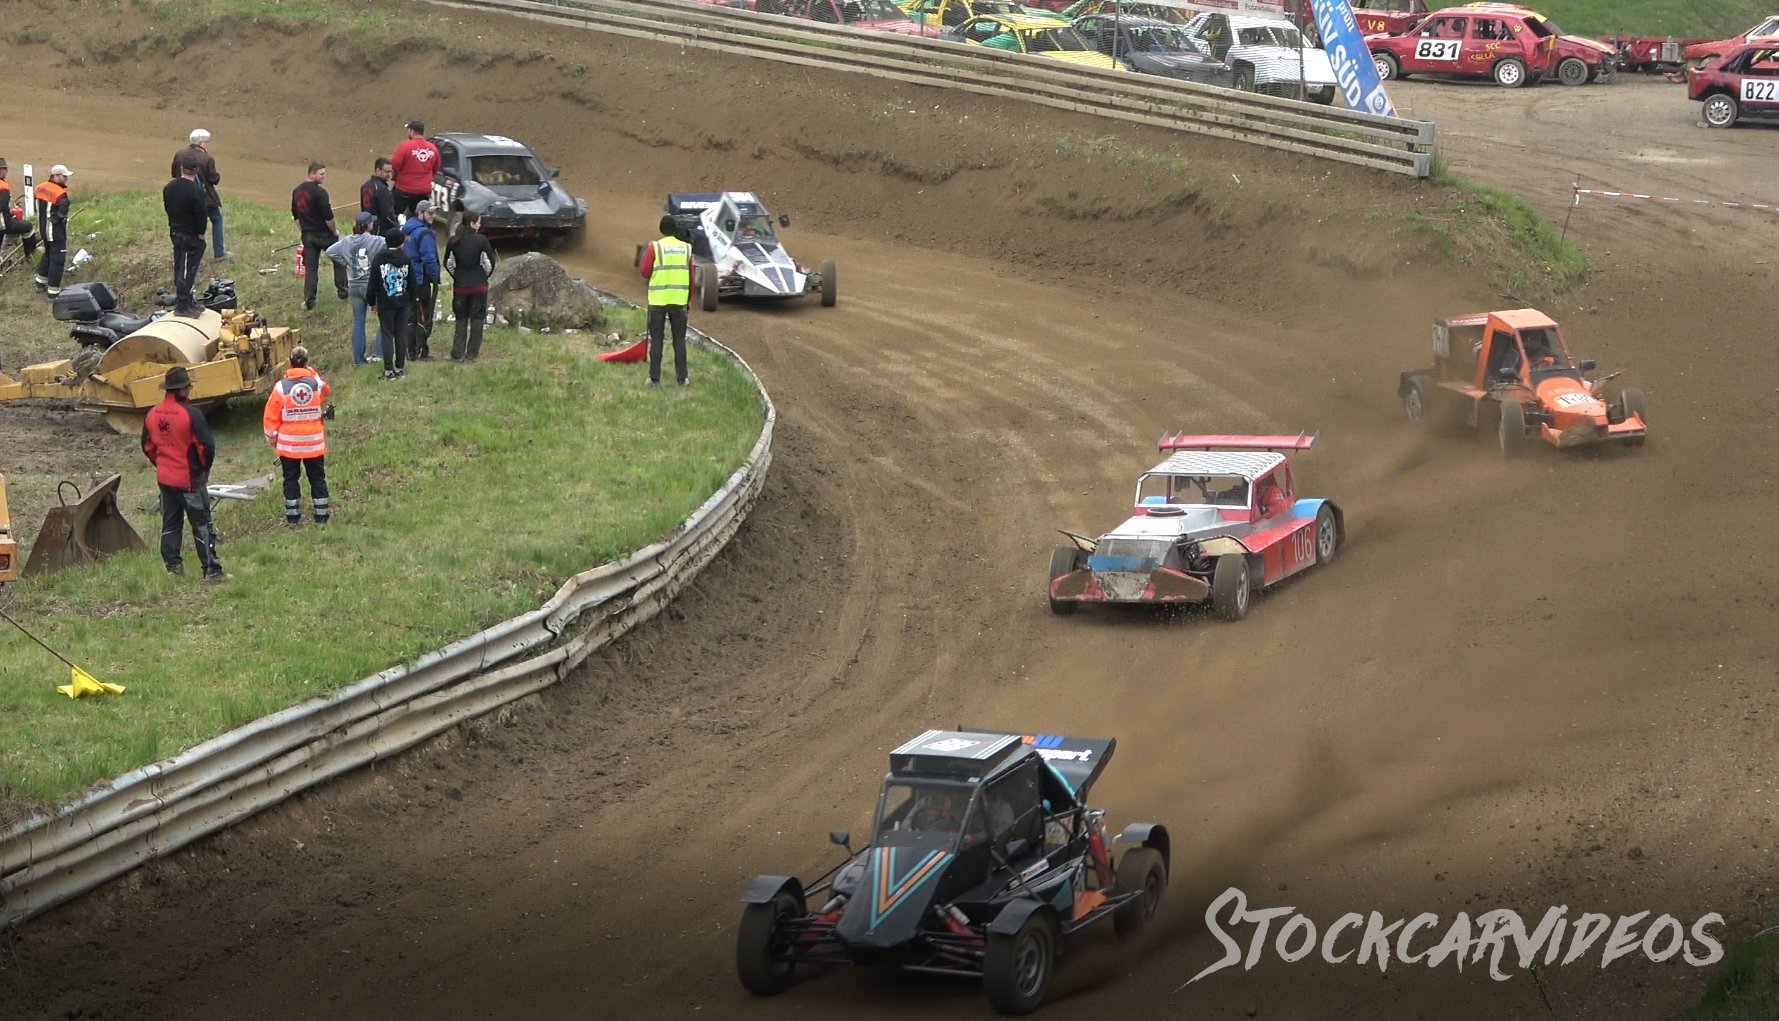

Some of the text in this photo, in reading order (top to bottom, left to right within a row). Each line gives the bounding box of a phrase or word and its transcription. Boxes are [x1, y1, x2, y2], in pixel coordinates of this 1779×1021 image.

[1367, 20, 1385, 31] V8
[1418, 42, 1459, 58] 831
[1331, 44, 1361, 107] SÜD
[1745, 81, 1775, 100] 822
[1292, 526, 1312, 563] 106
